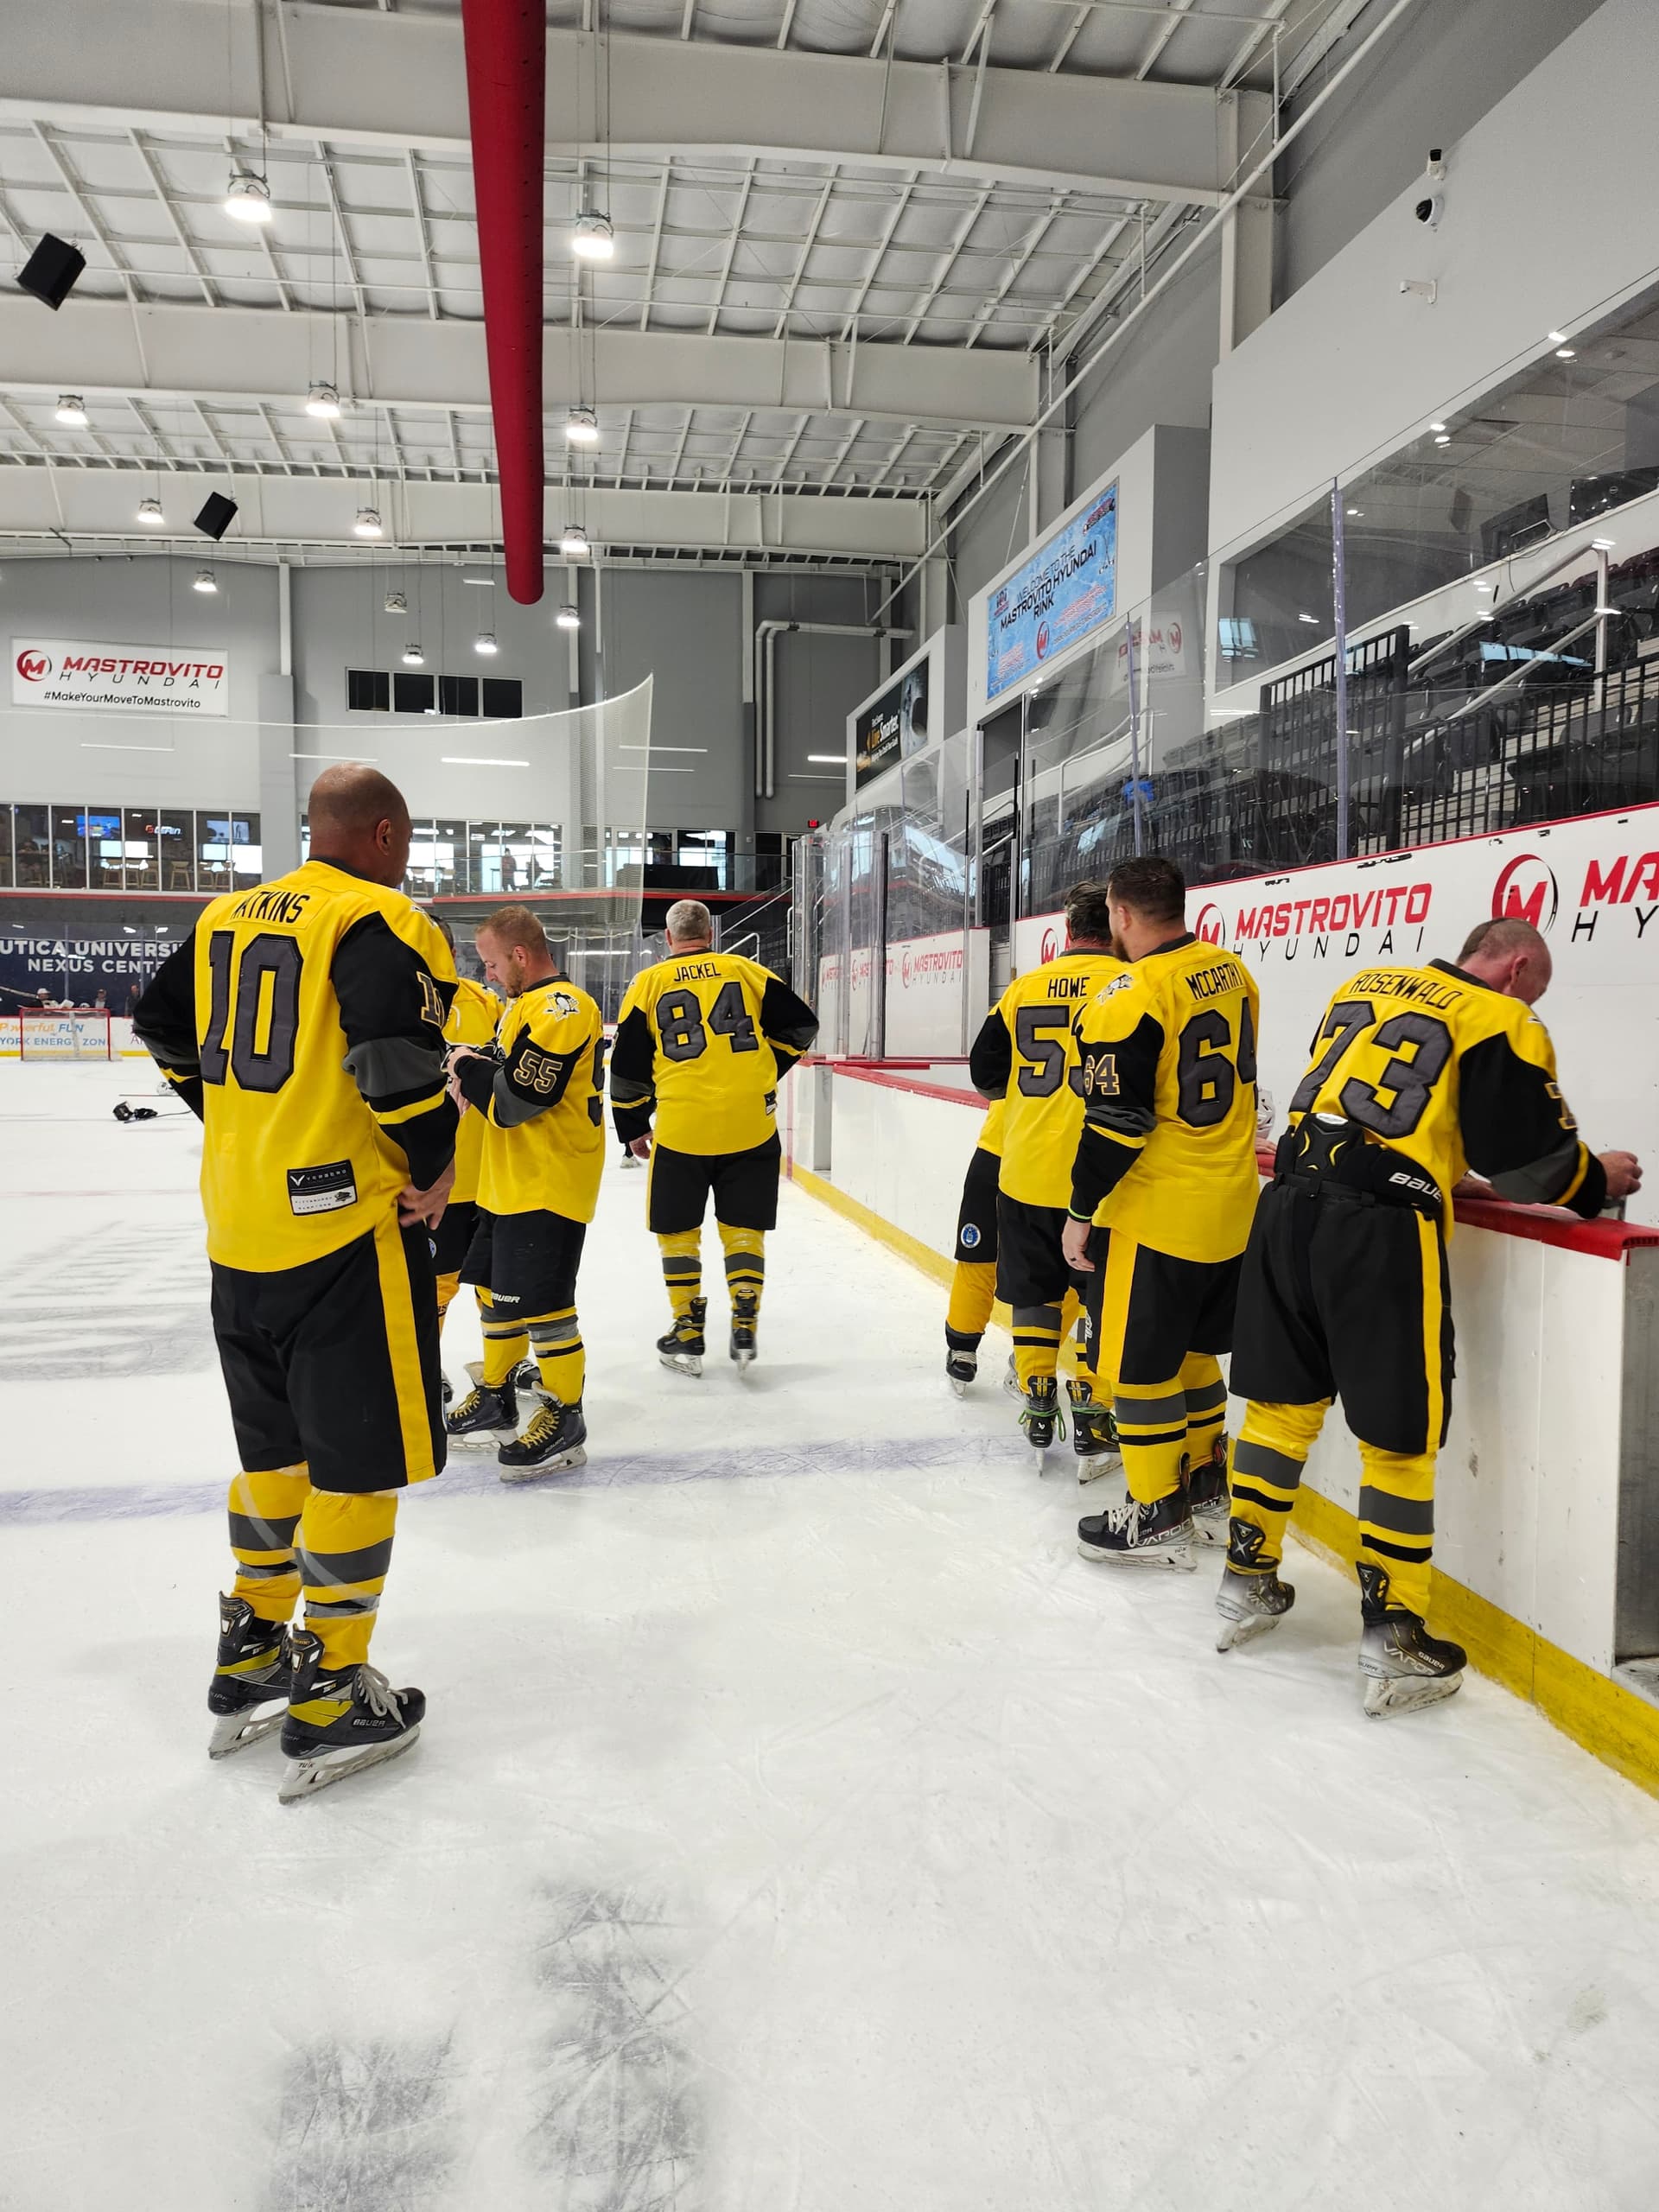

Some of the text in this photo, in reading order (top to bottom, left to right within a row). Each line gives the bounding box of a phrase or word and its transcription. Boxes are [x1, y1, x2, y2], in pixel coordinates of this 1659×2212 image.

[1001, 578, 1052, 632] MASTROVITO
[1053, 539, 1096, 589] HYUNDAI
[1033, 592, 1054, 620] RINK
[60, 671, 219, 690] HYUNDAI
[63, 657, 224, 679] MASTROVITO
[44, 691, 200, 708] #MakeYourMoveToMastrovito
[230, 890, 310, 924] ATKINS
[1236, 883, 1432, 940] MASTROVITO
[0, 940, 182, 957] UTICA UNIVERSI
[913, 950, 963, 973] MASTROVITO
[28, 958, 94, 973] NEXUS
[674, 963, 721, 982] JACKEL
[1047, 976, 1090, 998] HOWE
[1349, 974, 1463, 1010] ROSENWALD
[200, 931, 304, 1093] 10
[656, 982, 760, 1063] 84
[35, 1038, 73, 1046] ENERG
[514, 1049, 563, 1094] 55
[1084, 1054, 1121, 1096] 64
[1289, 1001, 1454, 1140] 73
